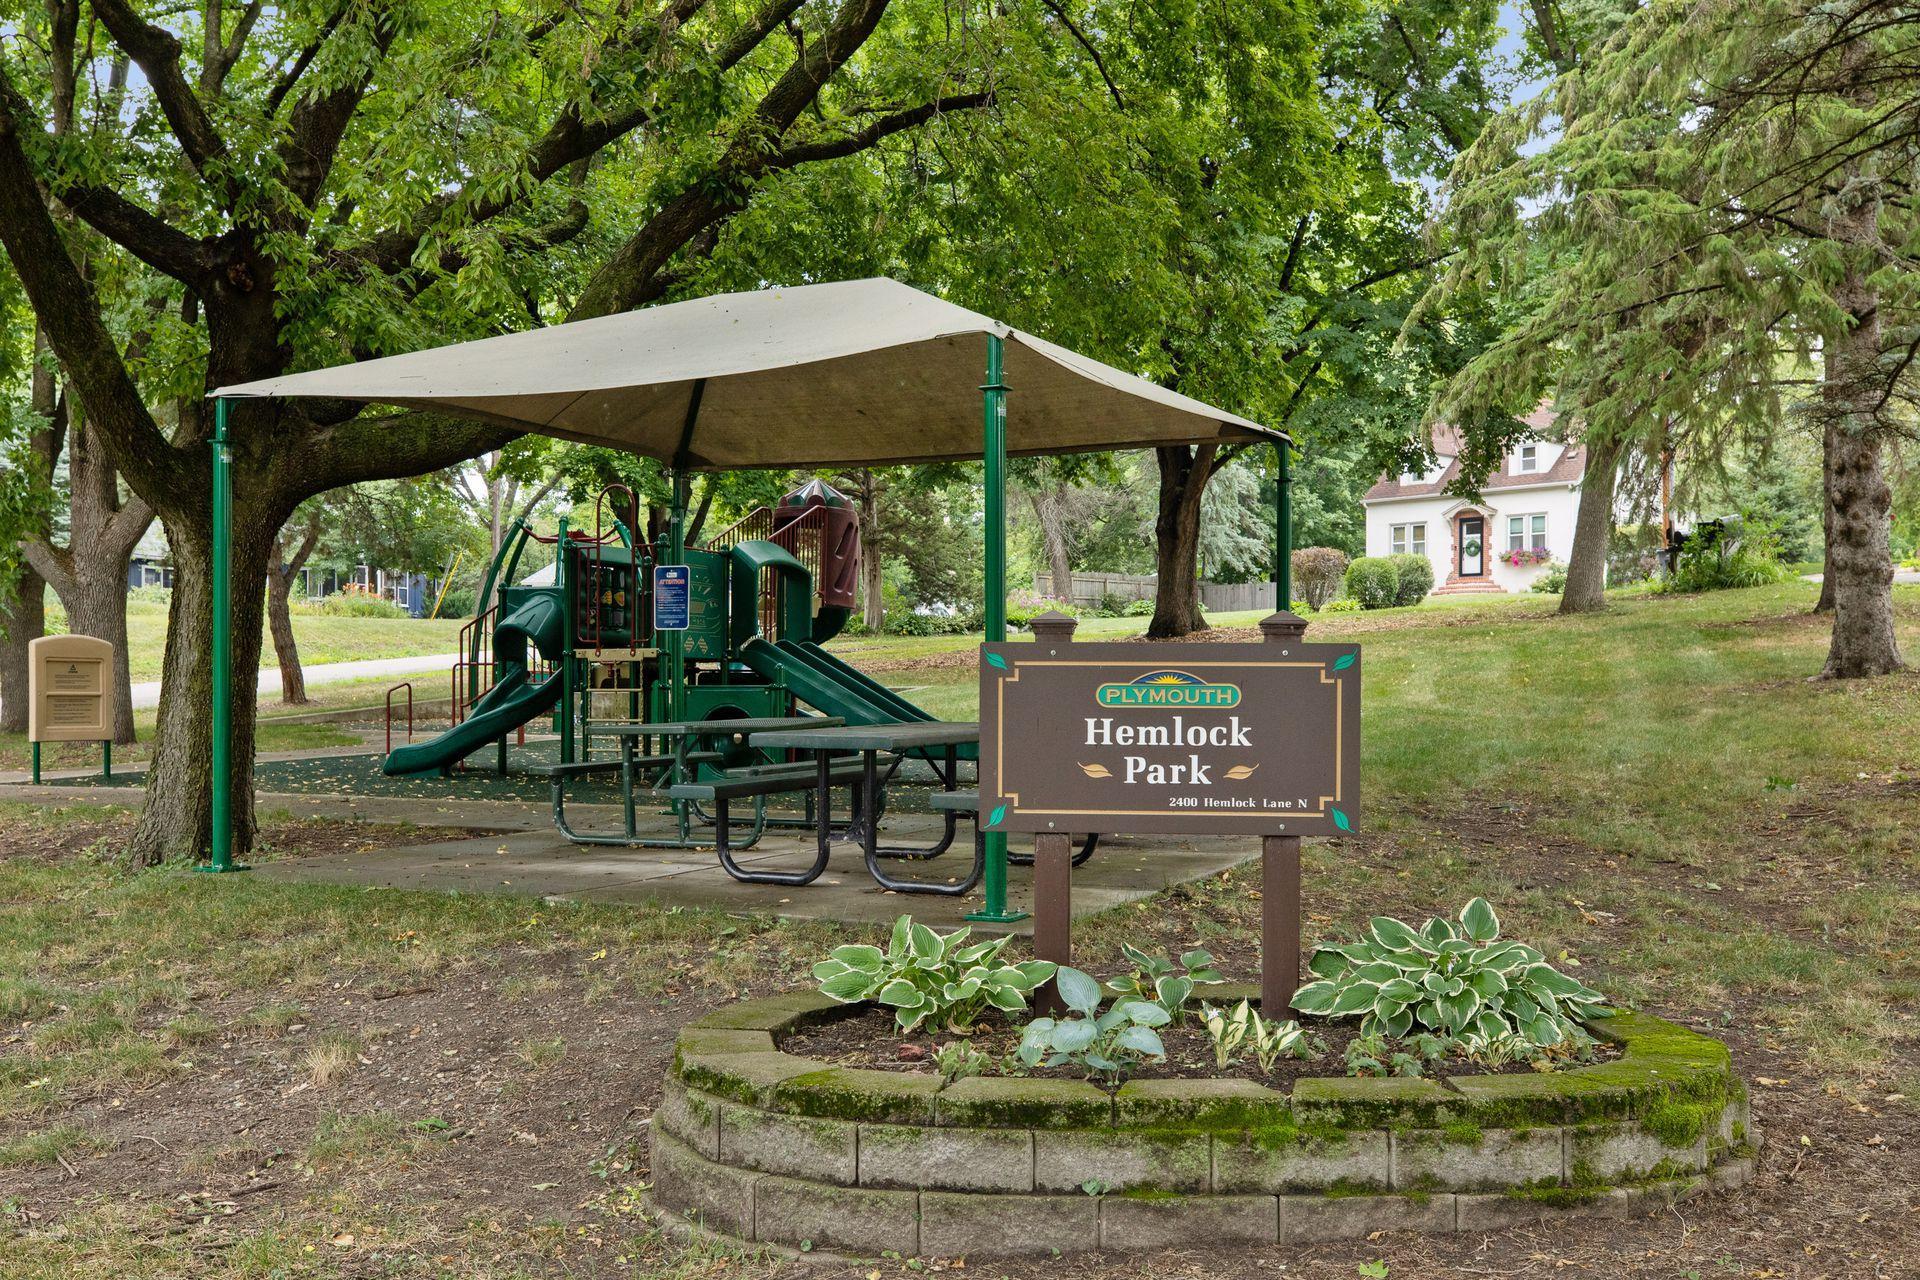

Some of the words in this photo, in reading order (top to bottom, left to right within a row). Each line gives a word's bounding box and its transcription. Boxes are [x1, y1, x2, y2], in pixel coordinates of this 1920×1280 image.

[1105, 688, 1233, 705] PLYMOUTH
[1084, 716, 1253, 747] Hemlock
[1124, 755, 1213, 785] Park
[1168, 797, 1198, 808] 2400
[1203, 797, 1256, 808] Hemlock
[1262, 798, 1292, 809] Lane
[1297, 798, 1308, 809] N
